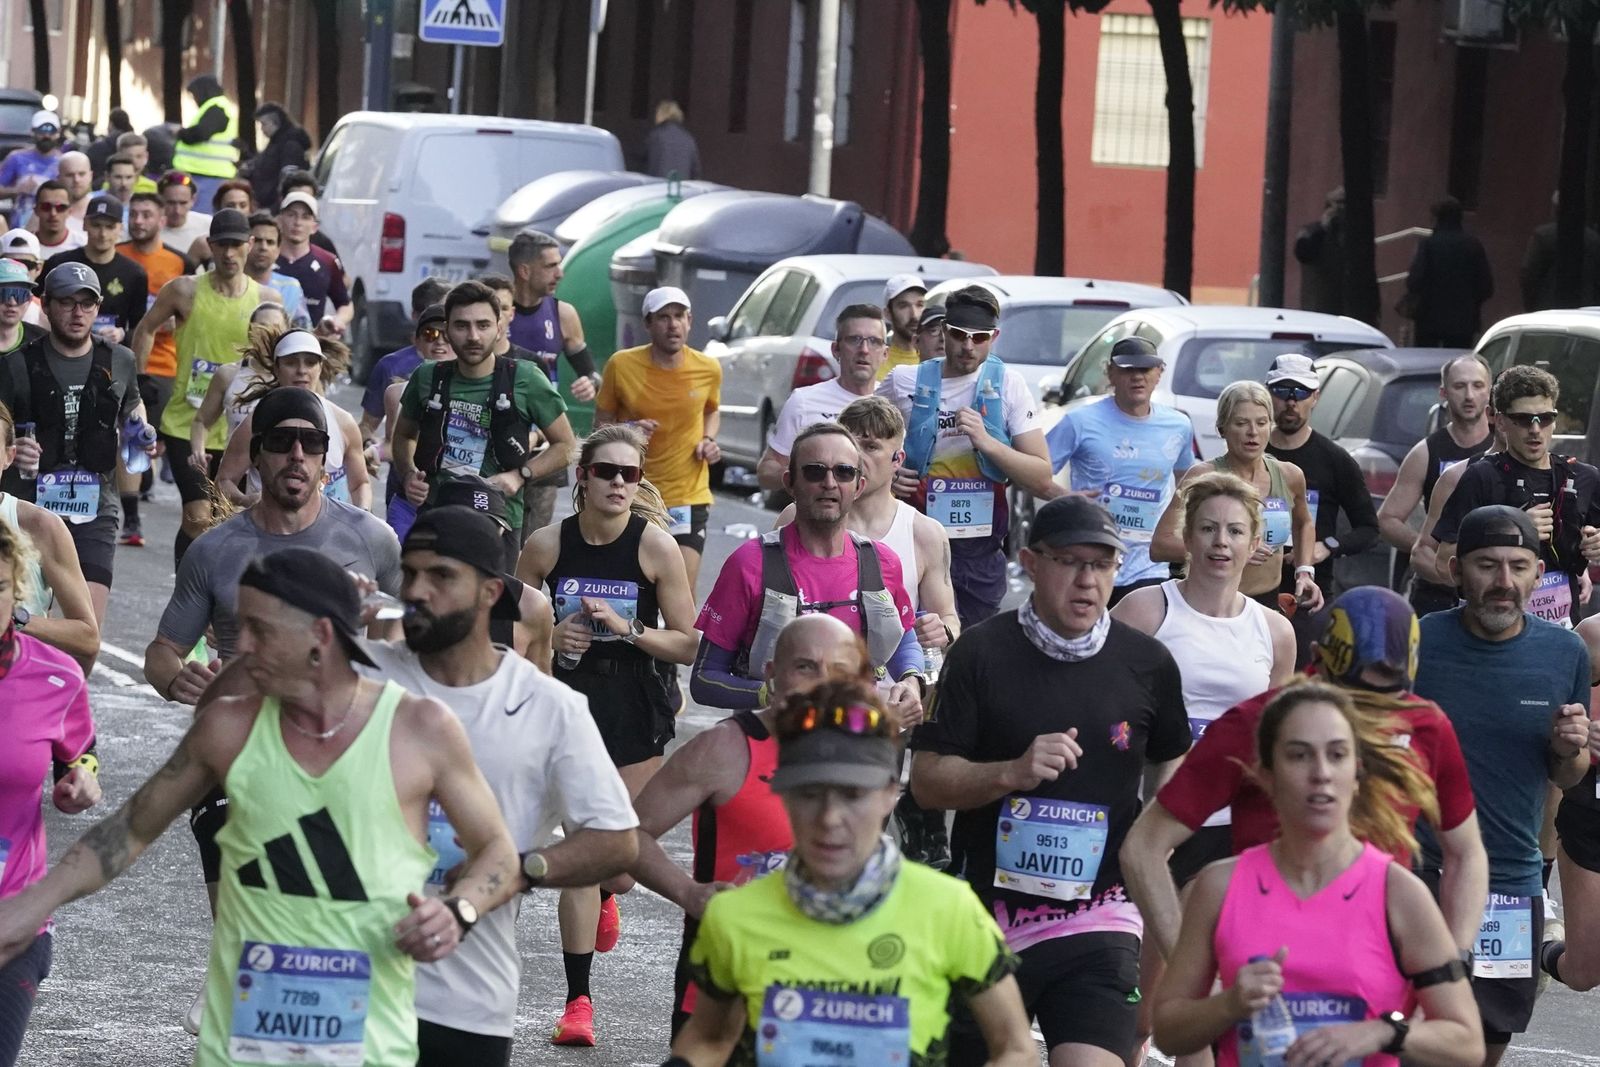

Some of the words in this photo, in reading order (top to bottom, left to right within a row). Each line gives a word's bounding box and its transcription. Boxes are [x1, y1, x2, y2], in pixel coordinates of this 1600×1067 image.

[950, 482, 987, 490] ZURICH
[1124, 488, 1156, 500] ZURICH
[44, 501, 89, 513] ARTHUR
[951, 499, 971, 508] 8878
[950, 512, 972, 524] ELS
[583, 583, 628, 596] ZURICH
[1532, 595, 1556, 608] 12364
[1037, 805, 1096, 822] ZURICH
[1036, 833, 1068, 849] 9513
[1015, 851, 1084, 877] JAVITO
[281, 953, 357, 973] ZURICH
[282, 989, 321, 1006] 7789
[811, 998, 894, 1023] ZURICH
[254, 1010, 343, 1038] XAVITO
